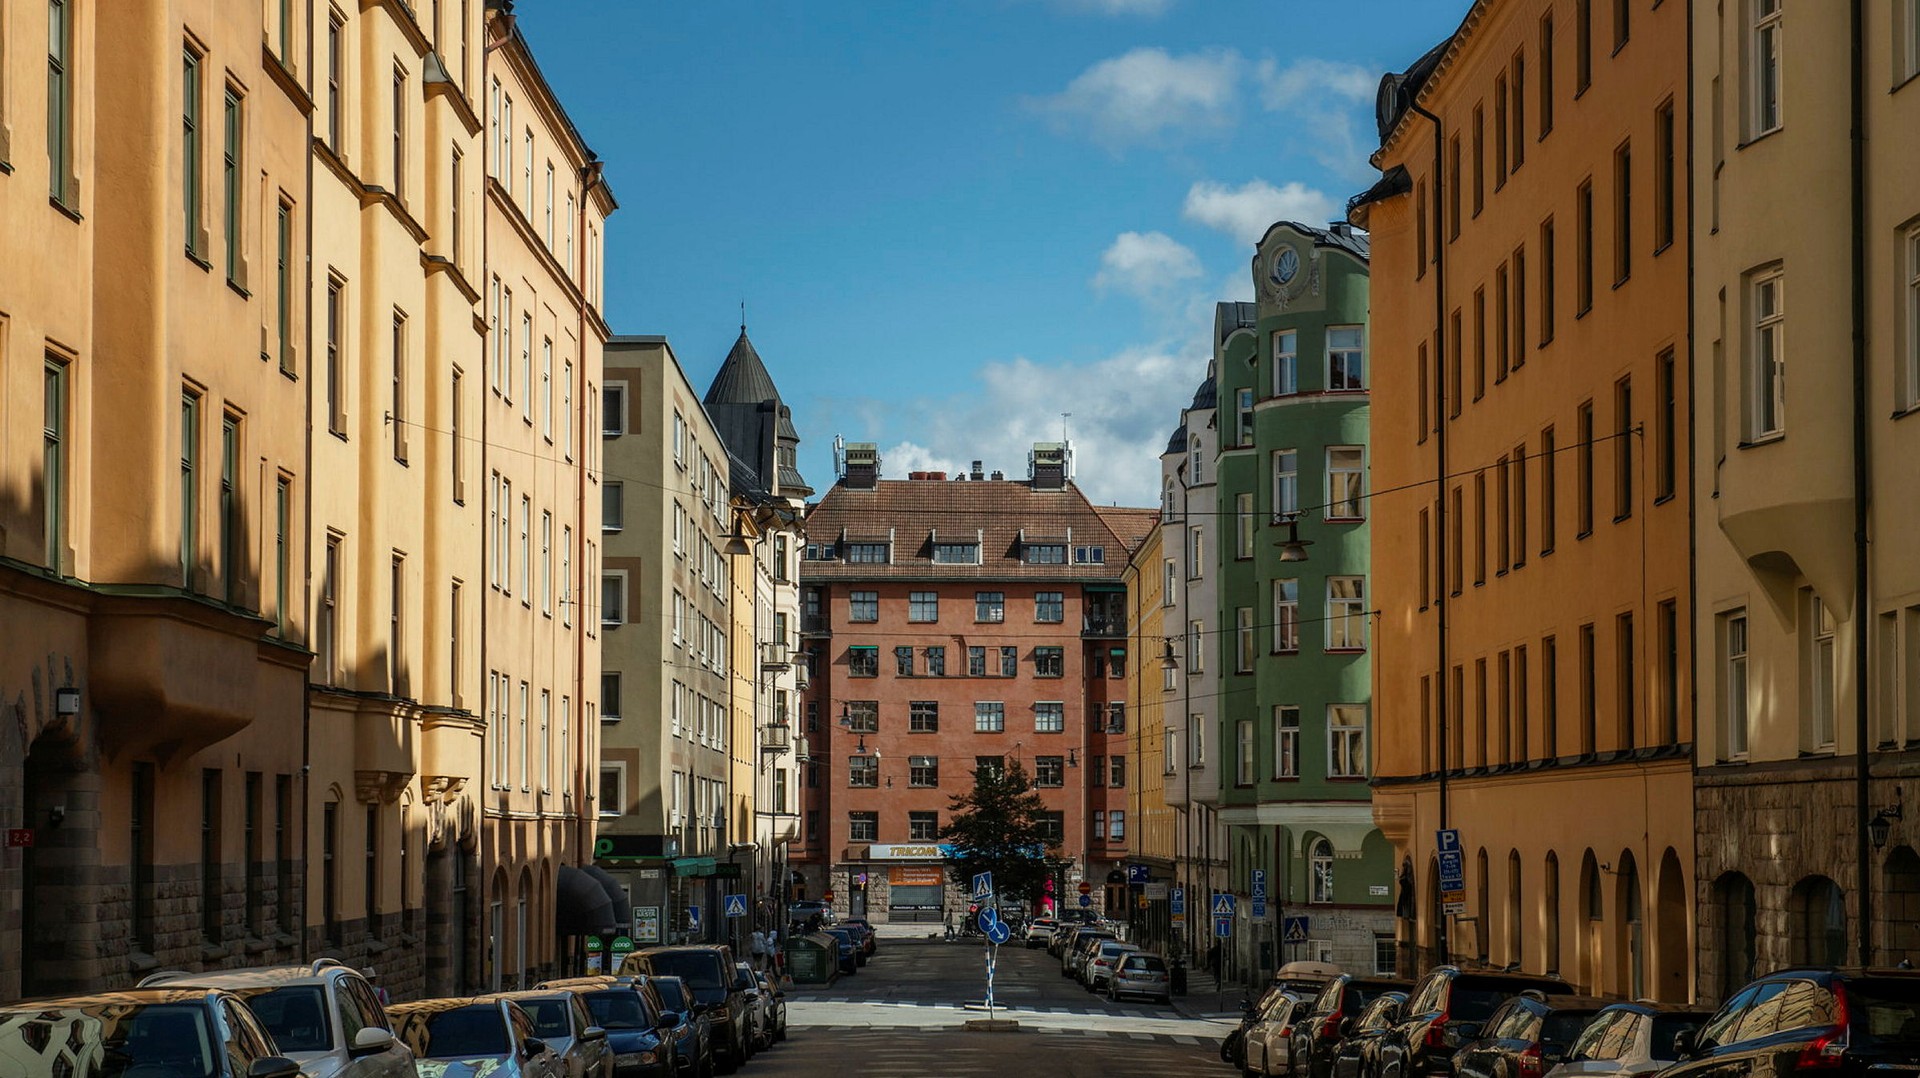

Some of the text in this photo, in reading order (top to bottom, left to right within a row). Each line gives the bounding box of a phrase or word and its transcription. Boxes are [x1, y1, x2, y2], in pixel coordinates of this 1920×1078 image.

[1442, 831, 1455, 850] P
[889, 846, 937, 856] TRICOM
[1255, 870, 1263, 882] P
[1174, 890, 1182, 900] P
